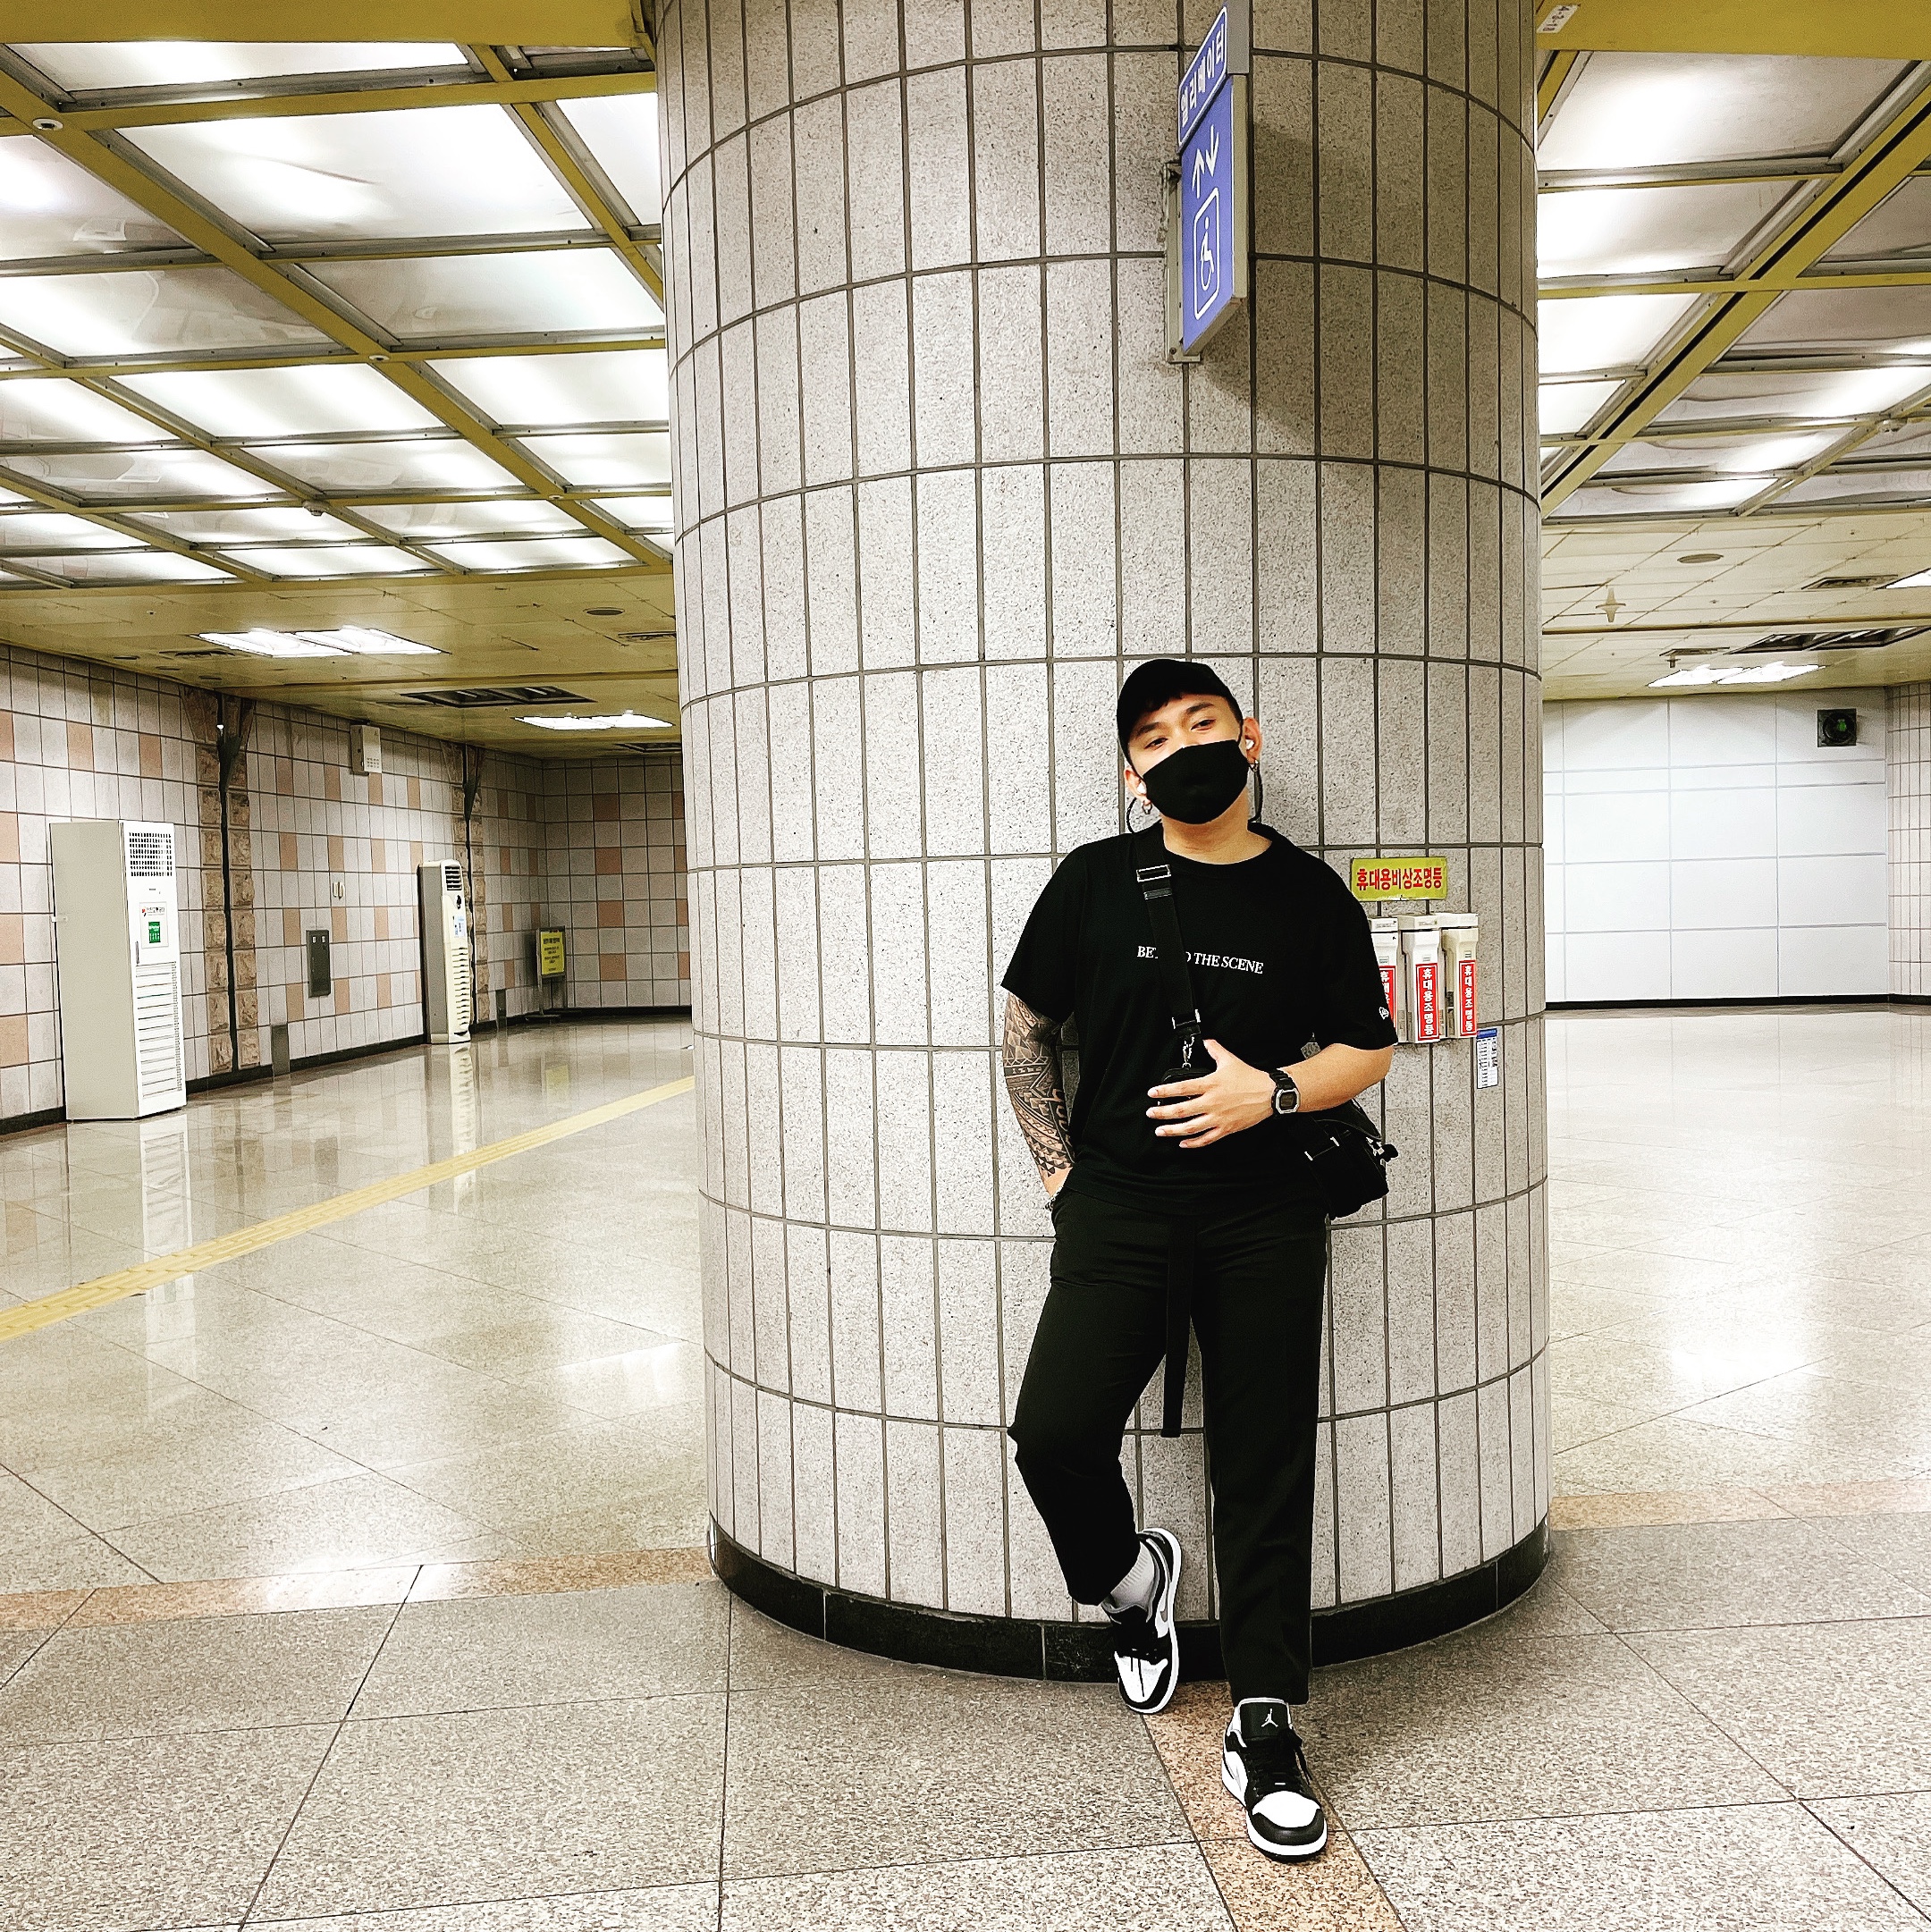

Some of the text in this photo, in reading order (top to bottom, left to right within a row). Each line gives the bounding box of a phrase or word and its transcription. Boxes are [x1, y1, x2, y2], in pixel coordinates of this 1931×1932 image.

[1181, 23, 1224, 128] 엘리베이터
[1356, 867, 1442, 891] 휴대용비상조명등
[1194, 952, 1220, 966] THE
[1221, 956, 1264, 974] SCENE
[1422, 968, 1434, 1035] 휴대용조명등
[1464, 965, 1473, 1032] 휴대용조명등
